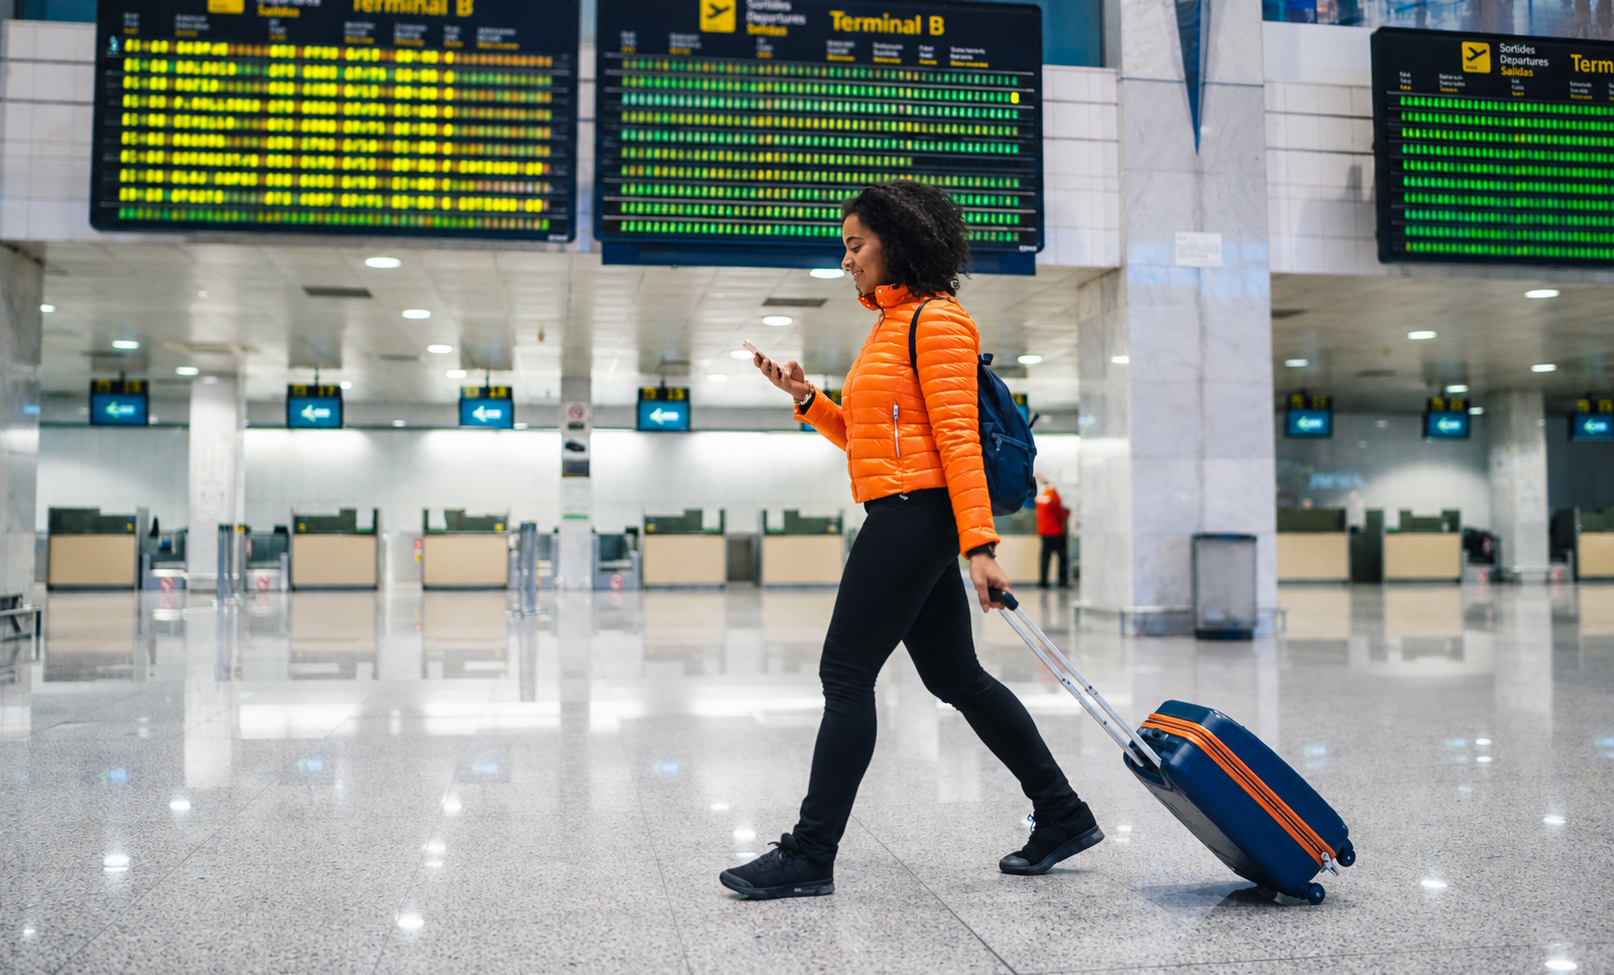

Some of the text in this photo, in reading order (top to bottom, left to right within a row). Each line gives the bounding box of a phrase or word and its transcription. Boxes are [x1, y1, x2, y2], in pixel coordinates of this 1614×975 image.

[456, 0, 474, 17] B
[746, 10, 806, 25] Departures
[829, 10, 945, 36] Terminal B
[746, 23, 788, 37] Salidas
[1499, 43, 1536, 55] Sortides
[1500, 54, 1549, 67] Departures
[1570, 54, 1614, 74] Term
[1501, 66, 1534, 77] Salidas
